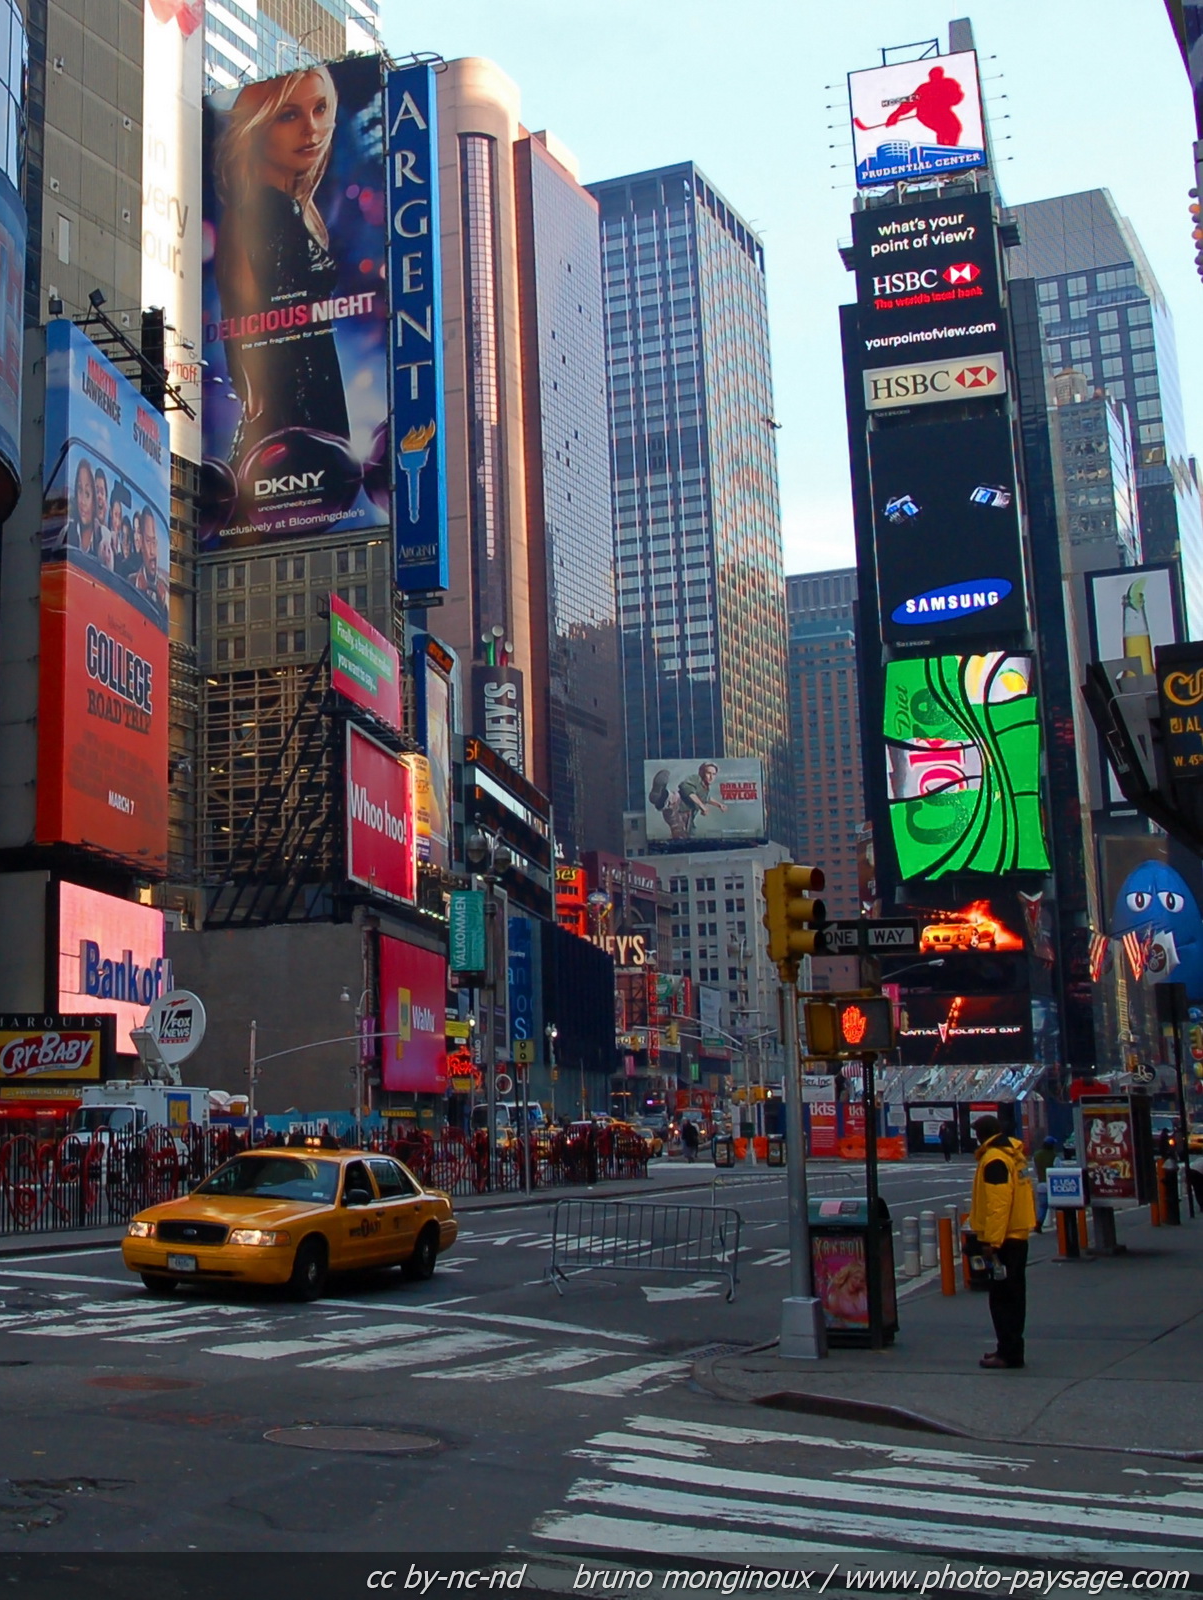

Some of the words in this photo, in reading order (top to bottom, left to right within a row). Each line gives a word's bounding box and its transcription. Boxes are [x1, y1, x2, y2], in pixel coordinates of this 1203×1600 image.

[861, 161, 933, 180] PRUDENTIAL
[935, 151, 981, 168] CENTER
[878, 217, 926, 236] what's
[929, 212, 965, 232] your
[390, 89, 433, 402] ARGENT
[870, 238, 910, 258] point
[912, 233, 929, 249] of
[931, 227, 975, 246] view?
[872, 268, 939, 296] HSBC
[206, 305, 309, 344] DELICIOUS
[311, 291, 377, 323] NIGHT
[254, 340, 268, 348] new
[865, 322, 997, 351] yourpointofview.com
[81, 370, 122, 427] LAWRENCE
[870, 370, 952, 401] HSBC
[254, 470, 326, 496] DKNY
[219, 522, 273, 537] exclusively
[275, 519, 286, 529] at
[289, 507, 366, 527] Bloomingdale's
[906, 591, 999, 613] SAMSUNG
[85, 623, 152, 714] COLLEGE
[87, 688, 122, 725] ROAD
[122, 703, 152, 735] TRIP
[894, 685, 908, 737] Diet
[108, 790, 130, 814] MARCH
[130, 800, 135, 815] 7
[350, 780, 384, 832] Whoo
[384, 799, 408, 846] hoo!
[824, 931, 853, 945] ONE
[874, 930, 907, 943] WAY
[80, 939, 140, 1002] Bank
[138, 957, 162, 1007] of
[171, 1016, 191, 1028] FOX
[412, 1004, 435, 1033] WaMu
[948, 1027, 997, 1035] SOLSTICE
[164, 1028, 191, 1039] NEWS
[809, 1102, 836, 1116] tkts
[1096, 1146, 1121, 1155] 101
[1052, 1185, 1078, 1193] TODAY
[1060, 1178, 1077, 1186] USA
